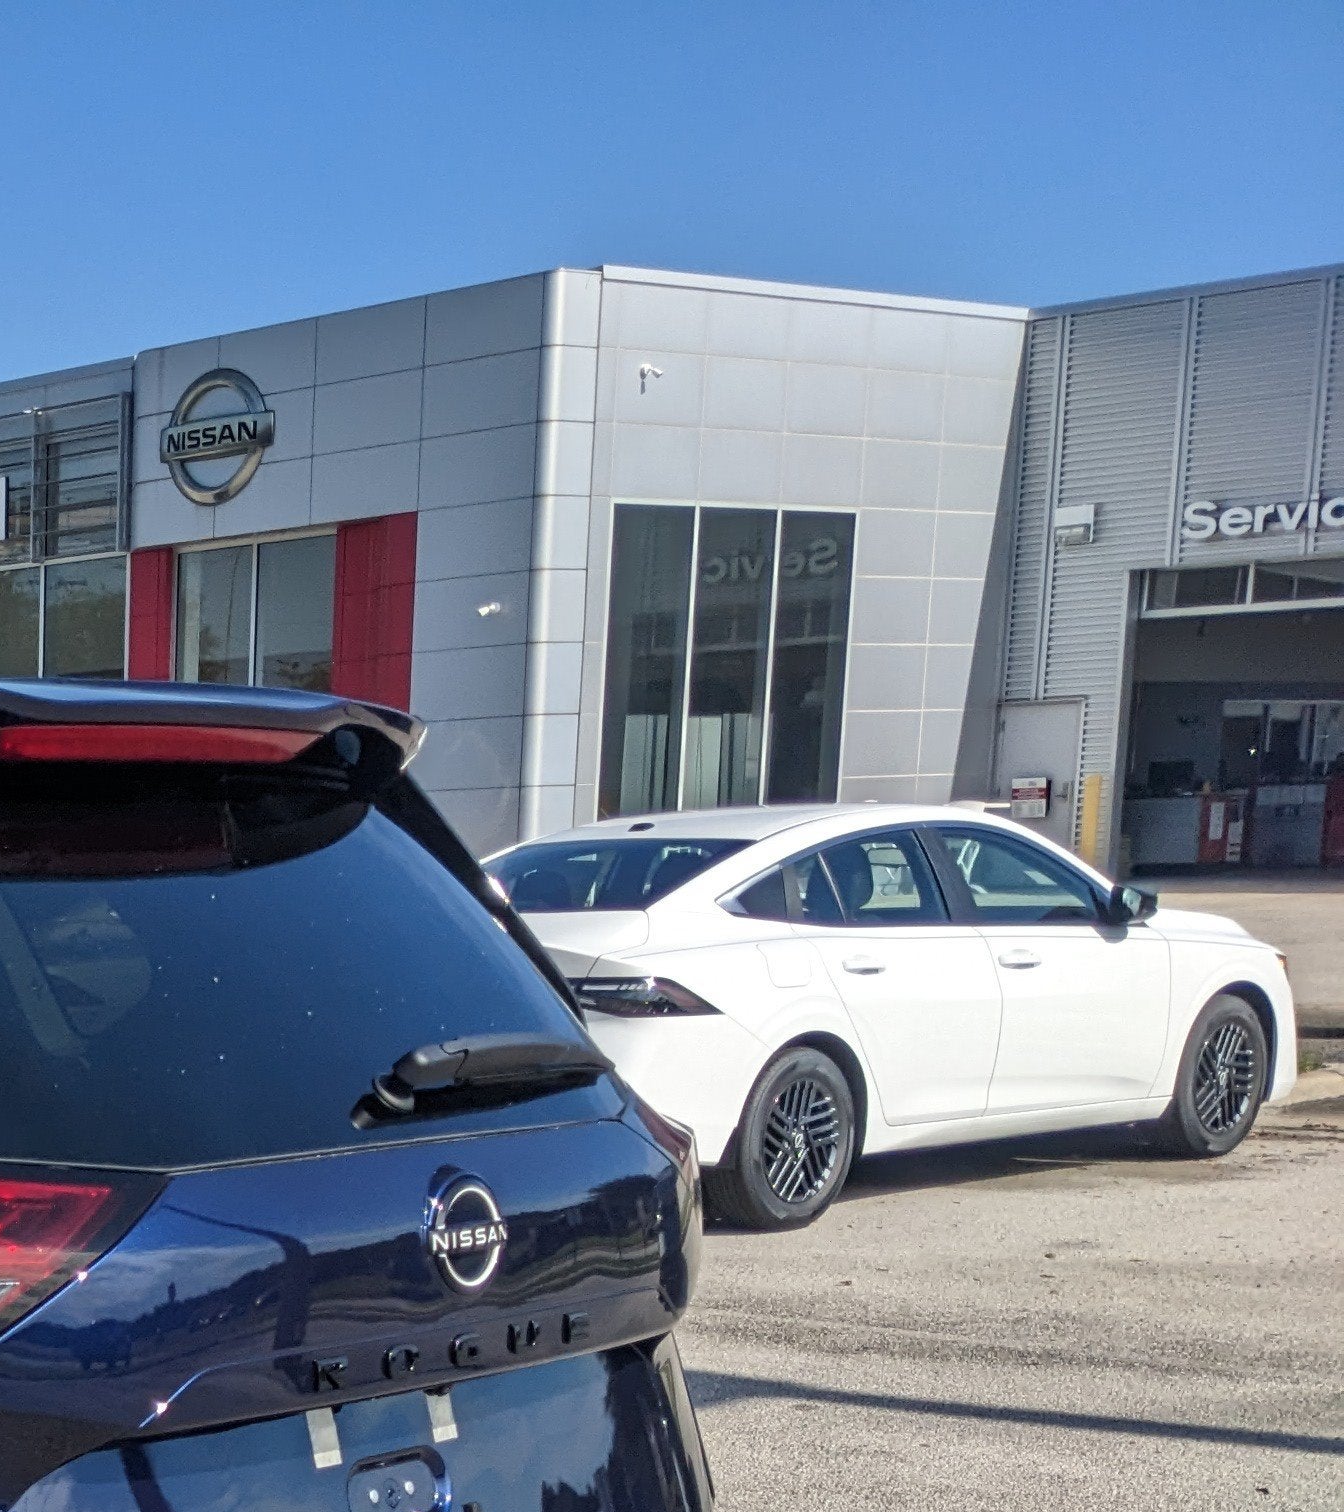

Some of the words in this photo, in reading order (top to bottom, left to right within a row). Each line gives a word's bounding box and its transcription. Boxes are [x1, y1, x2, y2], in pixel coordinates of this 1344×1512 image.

[167, 421, 258, 453] NISSAN
[431, 1224, 508, 1252] NISSAN
[311, 1311, 590, 1393] ROGUE
